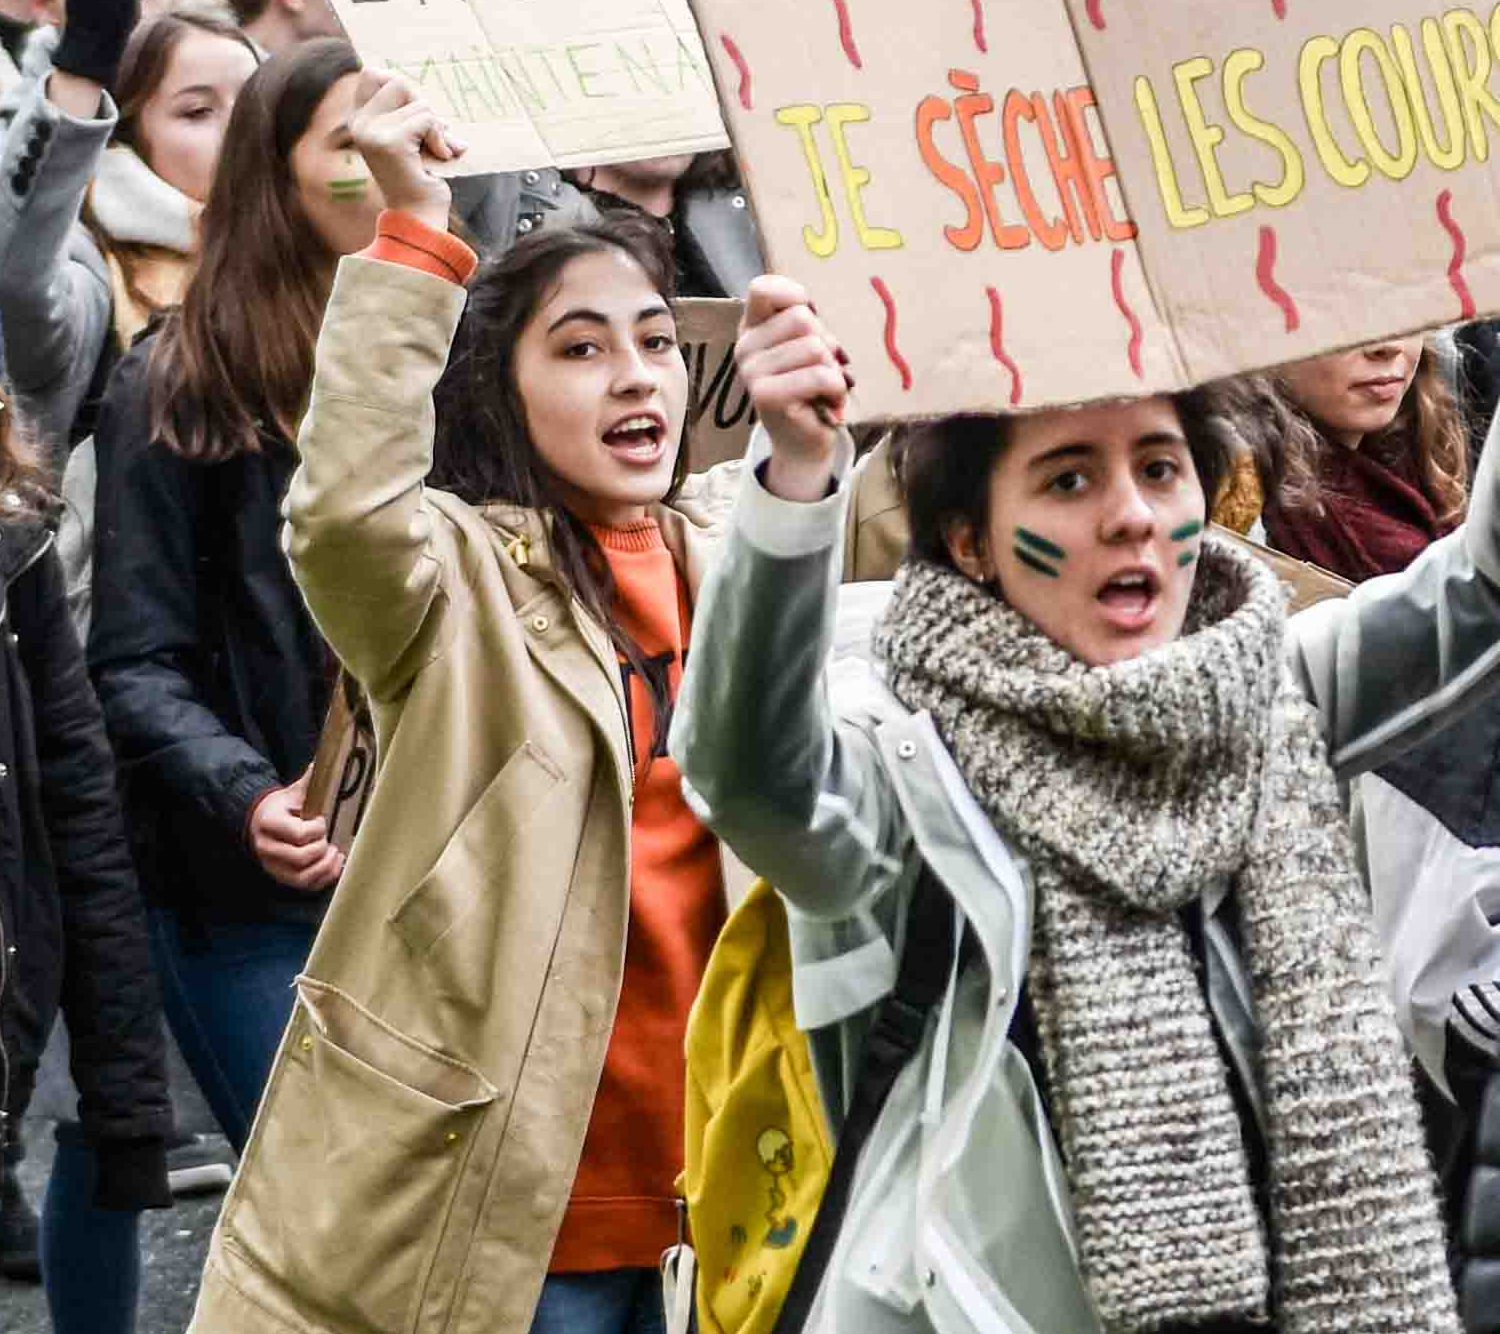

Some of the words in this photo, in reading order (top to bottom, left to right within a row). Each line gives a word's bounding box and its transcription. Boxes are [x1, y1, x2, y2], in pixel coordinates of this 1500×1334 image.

[773, 103, 905, 259] JE
[915, 67, 1140, 251] SÈCHE
[1133, 47, 1304, 233] LES
